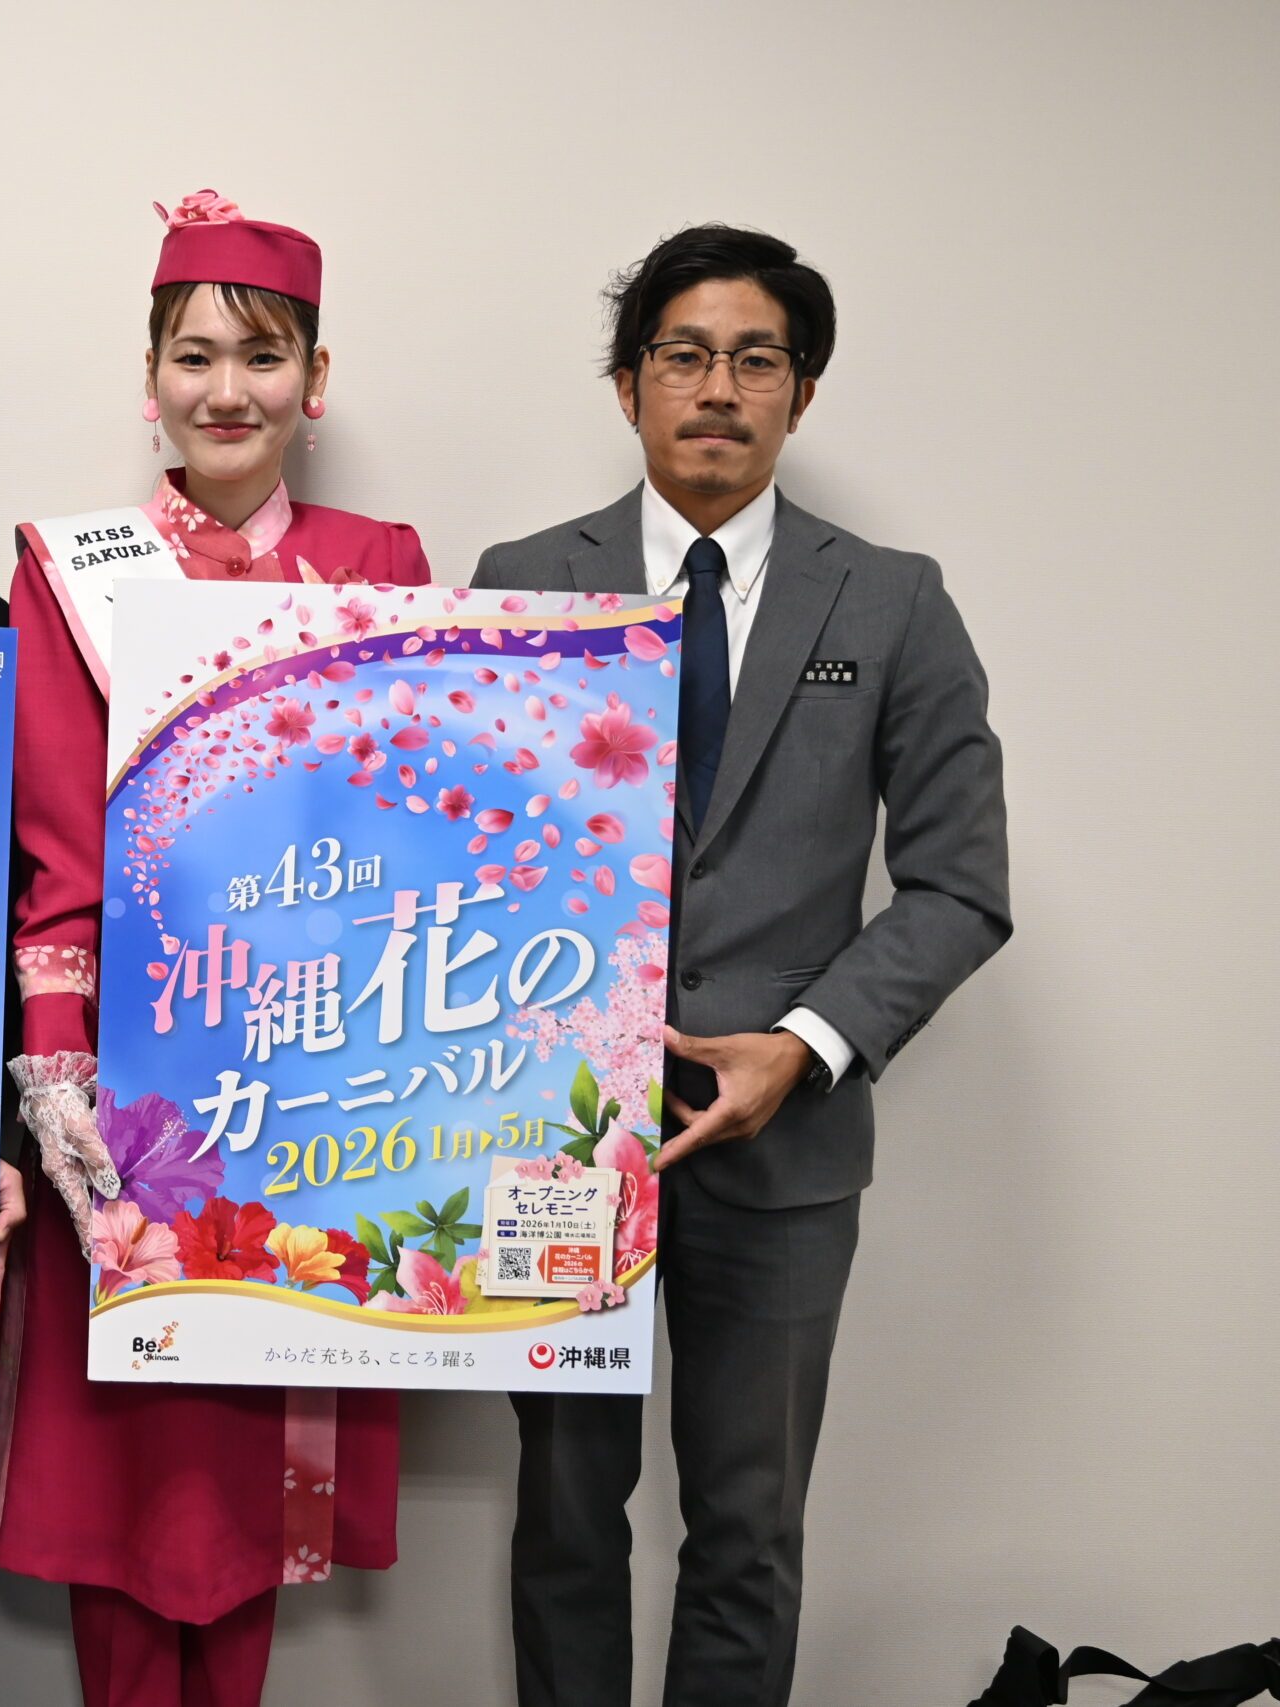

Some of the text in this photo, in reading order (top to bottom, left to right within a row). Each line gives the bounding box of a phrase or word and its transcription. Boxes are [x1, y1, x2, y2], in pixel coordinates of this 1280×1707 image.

[74, 525, 135, 546] MISS
[71, 540, 161, 571] SAKURA
[225, 837, 382, 912] 第43回
[187, 1039, 527, 1163] カーニバル
[264, 1117, 417, 1196] 2026
[508, 1186, 598, 1202] オープニング
[516, 1202, 588, 1215] セレモニー
[143, 1353, 180, 1362] Okinawa
[558, 1345, 632, 1370] 沖縄県
